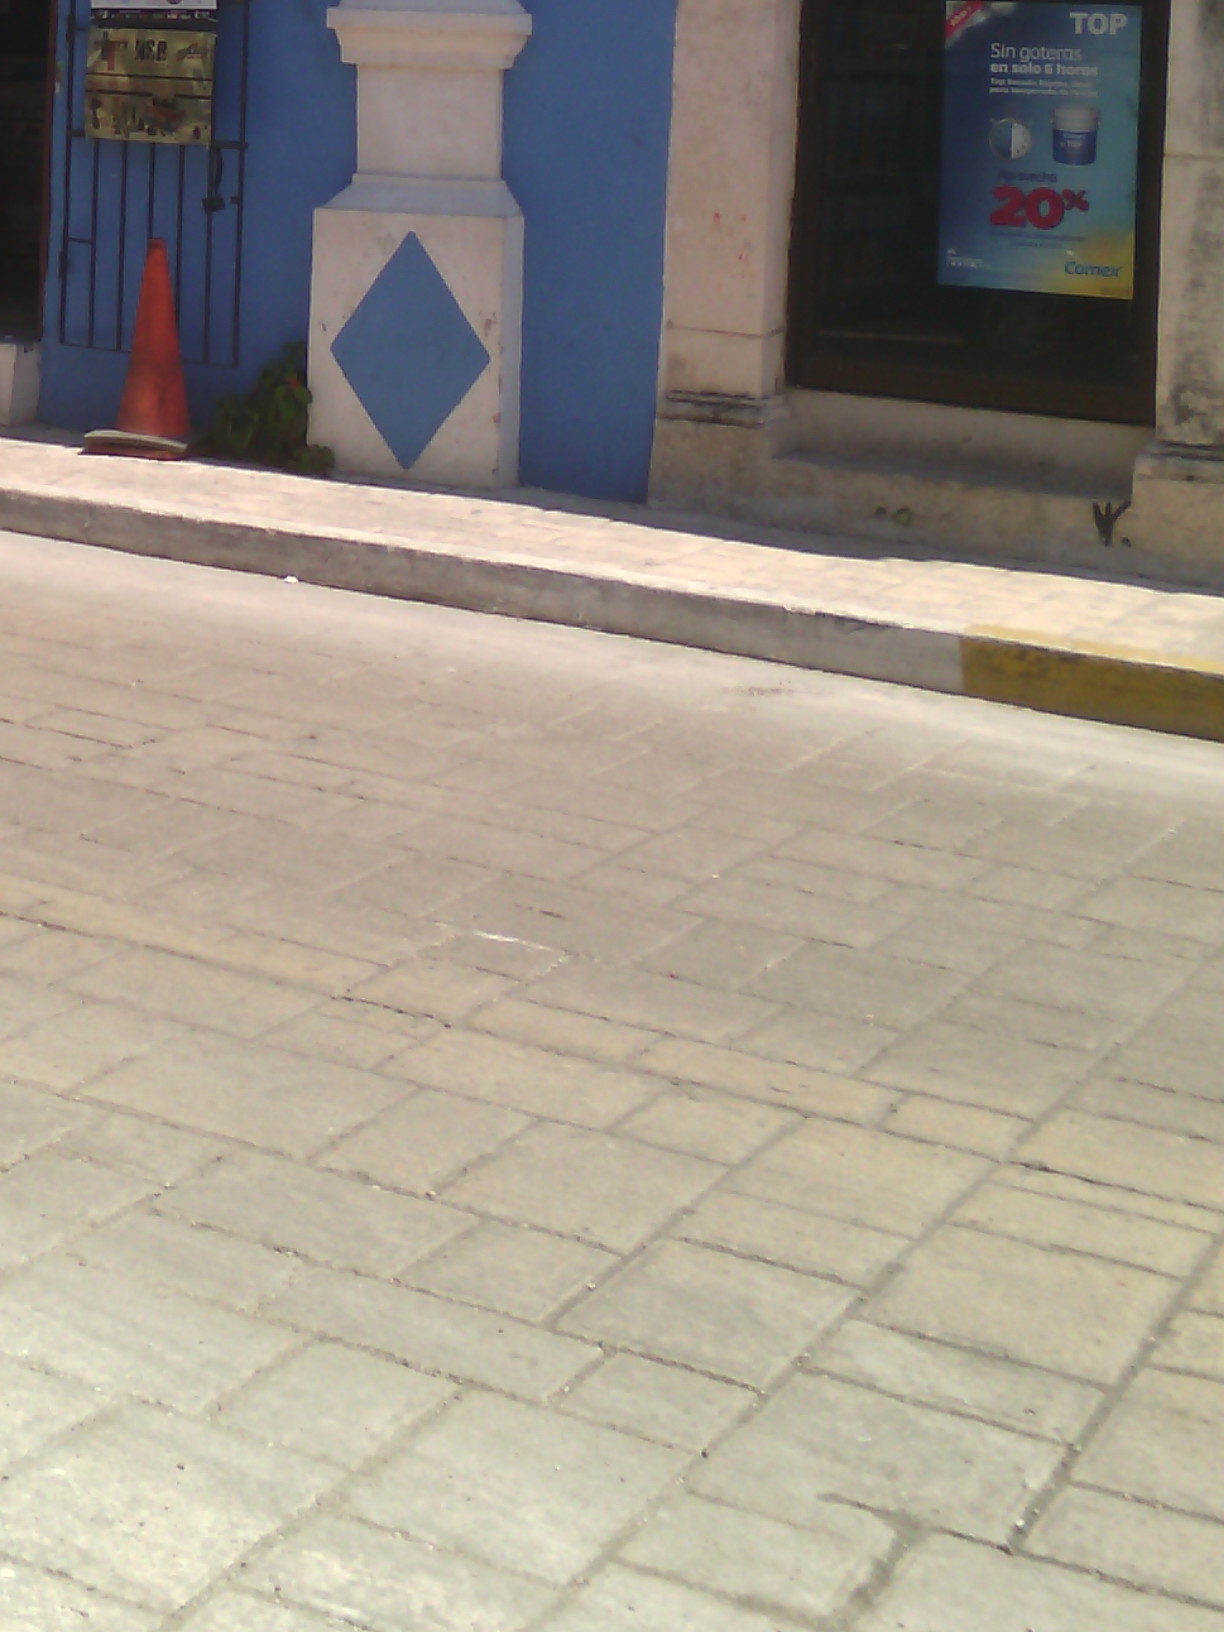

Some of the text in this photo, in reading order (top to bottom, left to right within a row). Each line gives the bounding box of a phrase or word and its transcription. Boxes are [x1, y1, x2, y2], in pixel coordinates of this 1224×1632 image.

[1069, 11, 1128, 36] TOP
[990, 42, 1083, 63] Sin goteras
[989, 62, 1009, 74] en
[989, 185, 1091, 231] 20%
[1063, 260, 1123, 278] Comex
